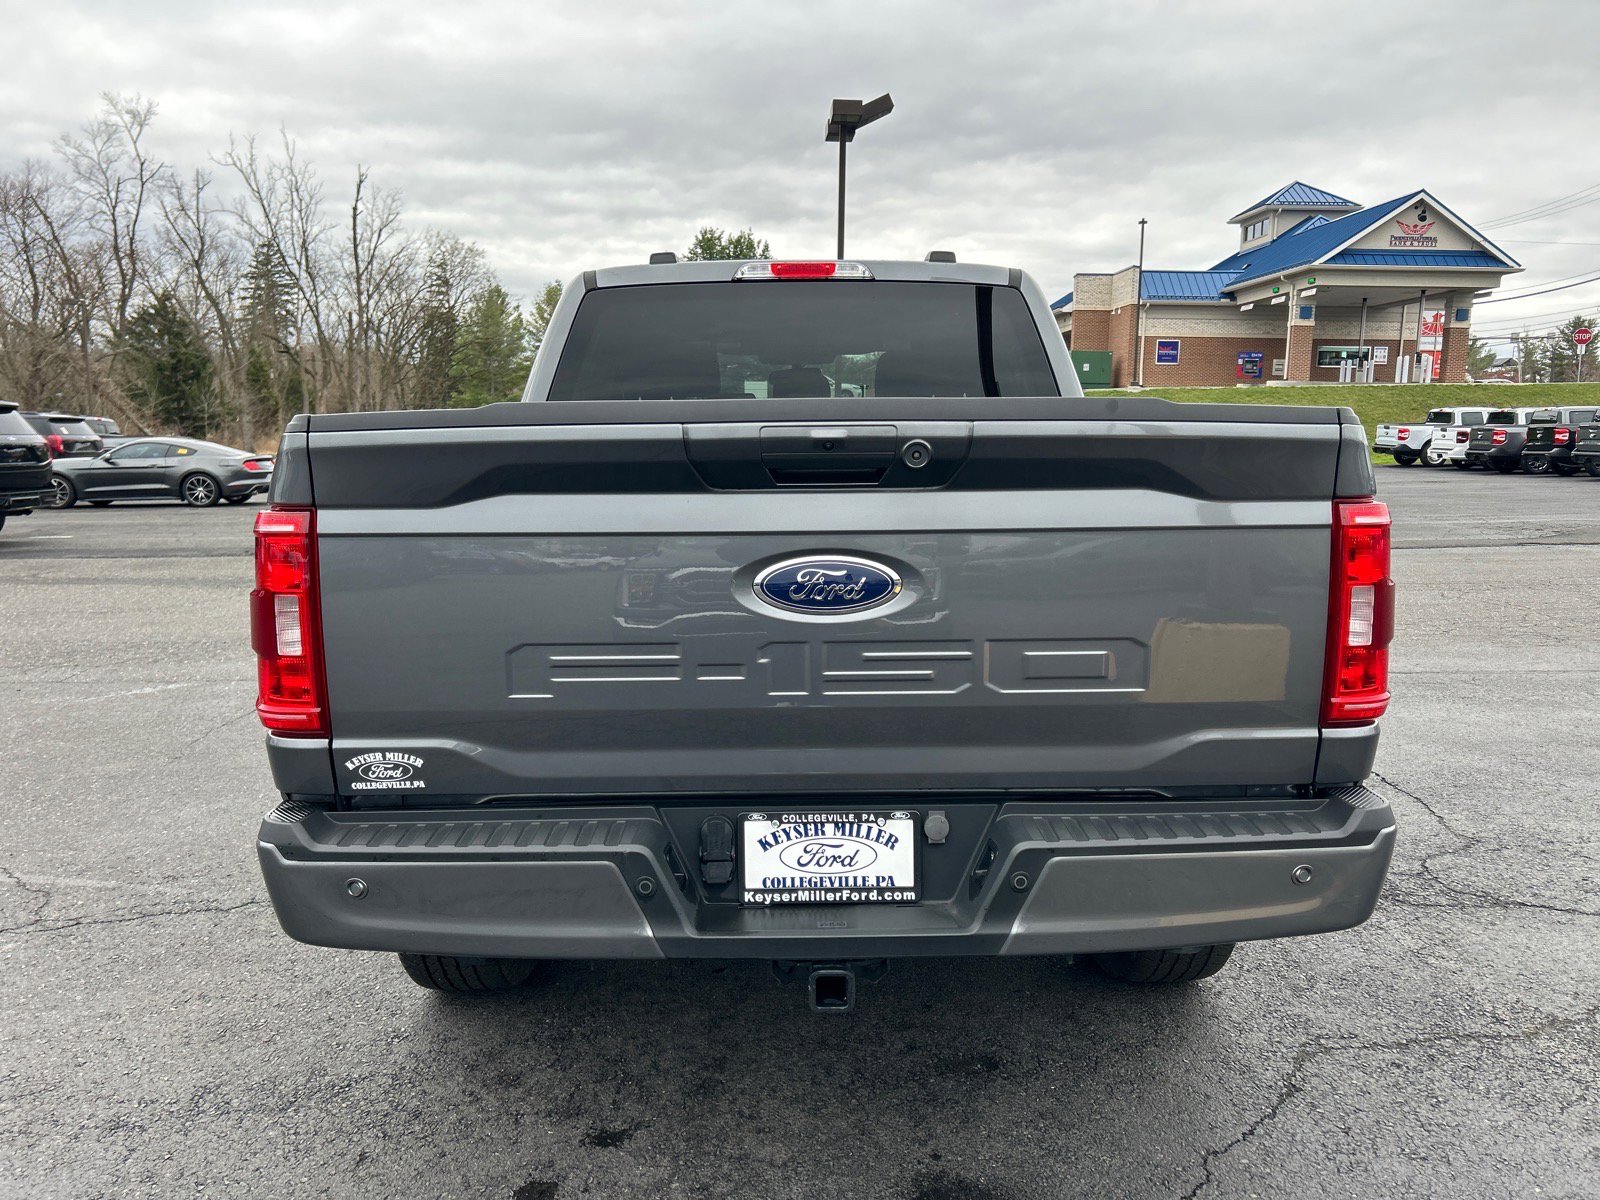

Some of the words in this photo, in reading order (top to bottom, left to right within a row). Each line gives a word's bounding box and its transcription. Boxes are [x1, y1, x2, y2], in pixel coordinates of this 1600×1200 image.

[788, 568, 866, 601] Ford
[504, 637, 1150, 699] F-150
[344, 752, 383, 771] KEYSER
[385, 751, 424, 768] MILLER
[368, 763, 404, 778] Ford
[782, 814, 858, 823] COLLEGEVILLE,
[862, 813, 876, 822] PA
[756, 823, 826, 853] KEYSER
[833, 823, 900, 851] MILLER
[796, 842, 860, 868] Ford
[744, 889, 916, 905] KeyserMillerFord.com
